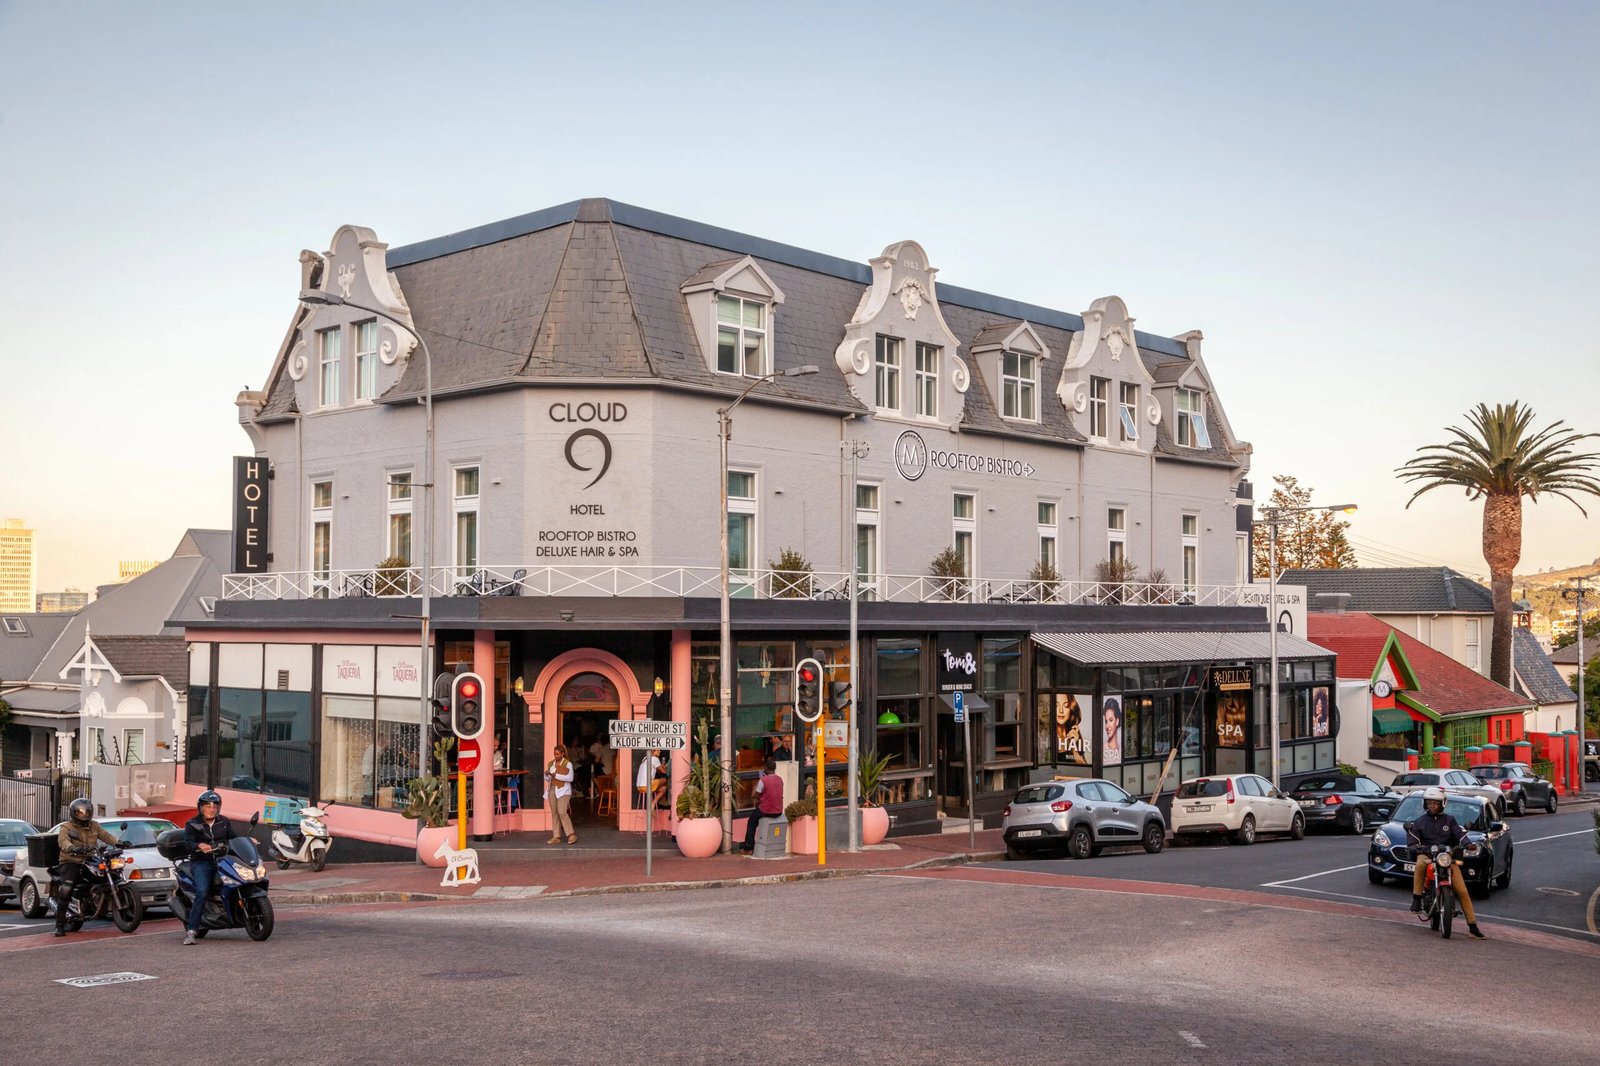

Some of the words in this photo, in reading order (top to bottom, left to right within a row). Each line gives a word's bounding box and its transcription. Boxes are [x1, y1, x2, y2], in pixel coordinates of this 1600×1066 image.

[549, 402, 627, 422] CLOUD
[564, 428, 612, 491] 9
[902, 443, 919, 466] M
[930, 450, 984, 471] ROOFTOP
[987, 457, 1022, 476] BISTRO
[244, 461, 260, 567] HOTEL
[570, 504, 605, 515] HOTEL
[539, 531, 594, 541] ROOFTOP
[597, 531, 636, 541] BISTRO
[536, 546, 577, 557] DELUXE
[580, 546, 605, 557] HAIR
[608, 547, 616, 556] &
[618, 546, 639, 557] SPA
[337, 664, 361, 680] TAQUERIA
[1222, 669, 1251, 684] DELUXE
[617, 722, 636, 732] NEW
[638, 723, 670, 733] CHURCH
[672, 724, 683, 734] ST
[1217, 724, 1243, 737] SPA
[616, 737, 641, 747] KLOOF
[645, 737, 662, 747] NEK
[665, 738, 676, 748] RD
[1058, 737, 1091, 752] HAIR
[1103, 749, 1120, 760] SPA
